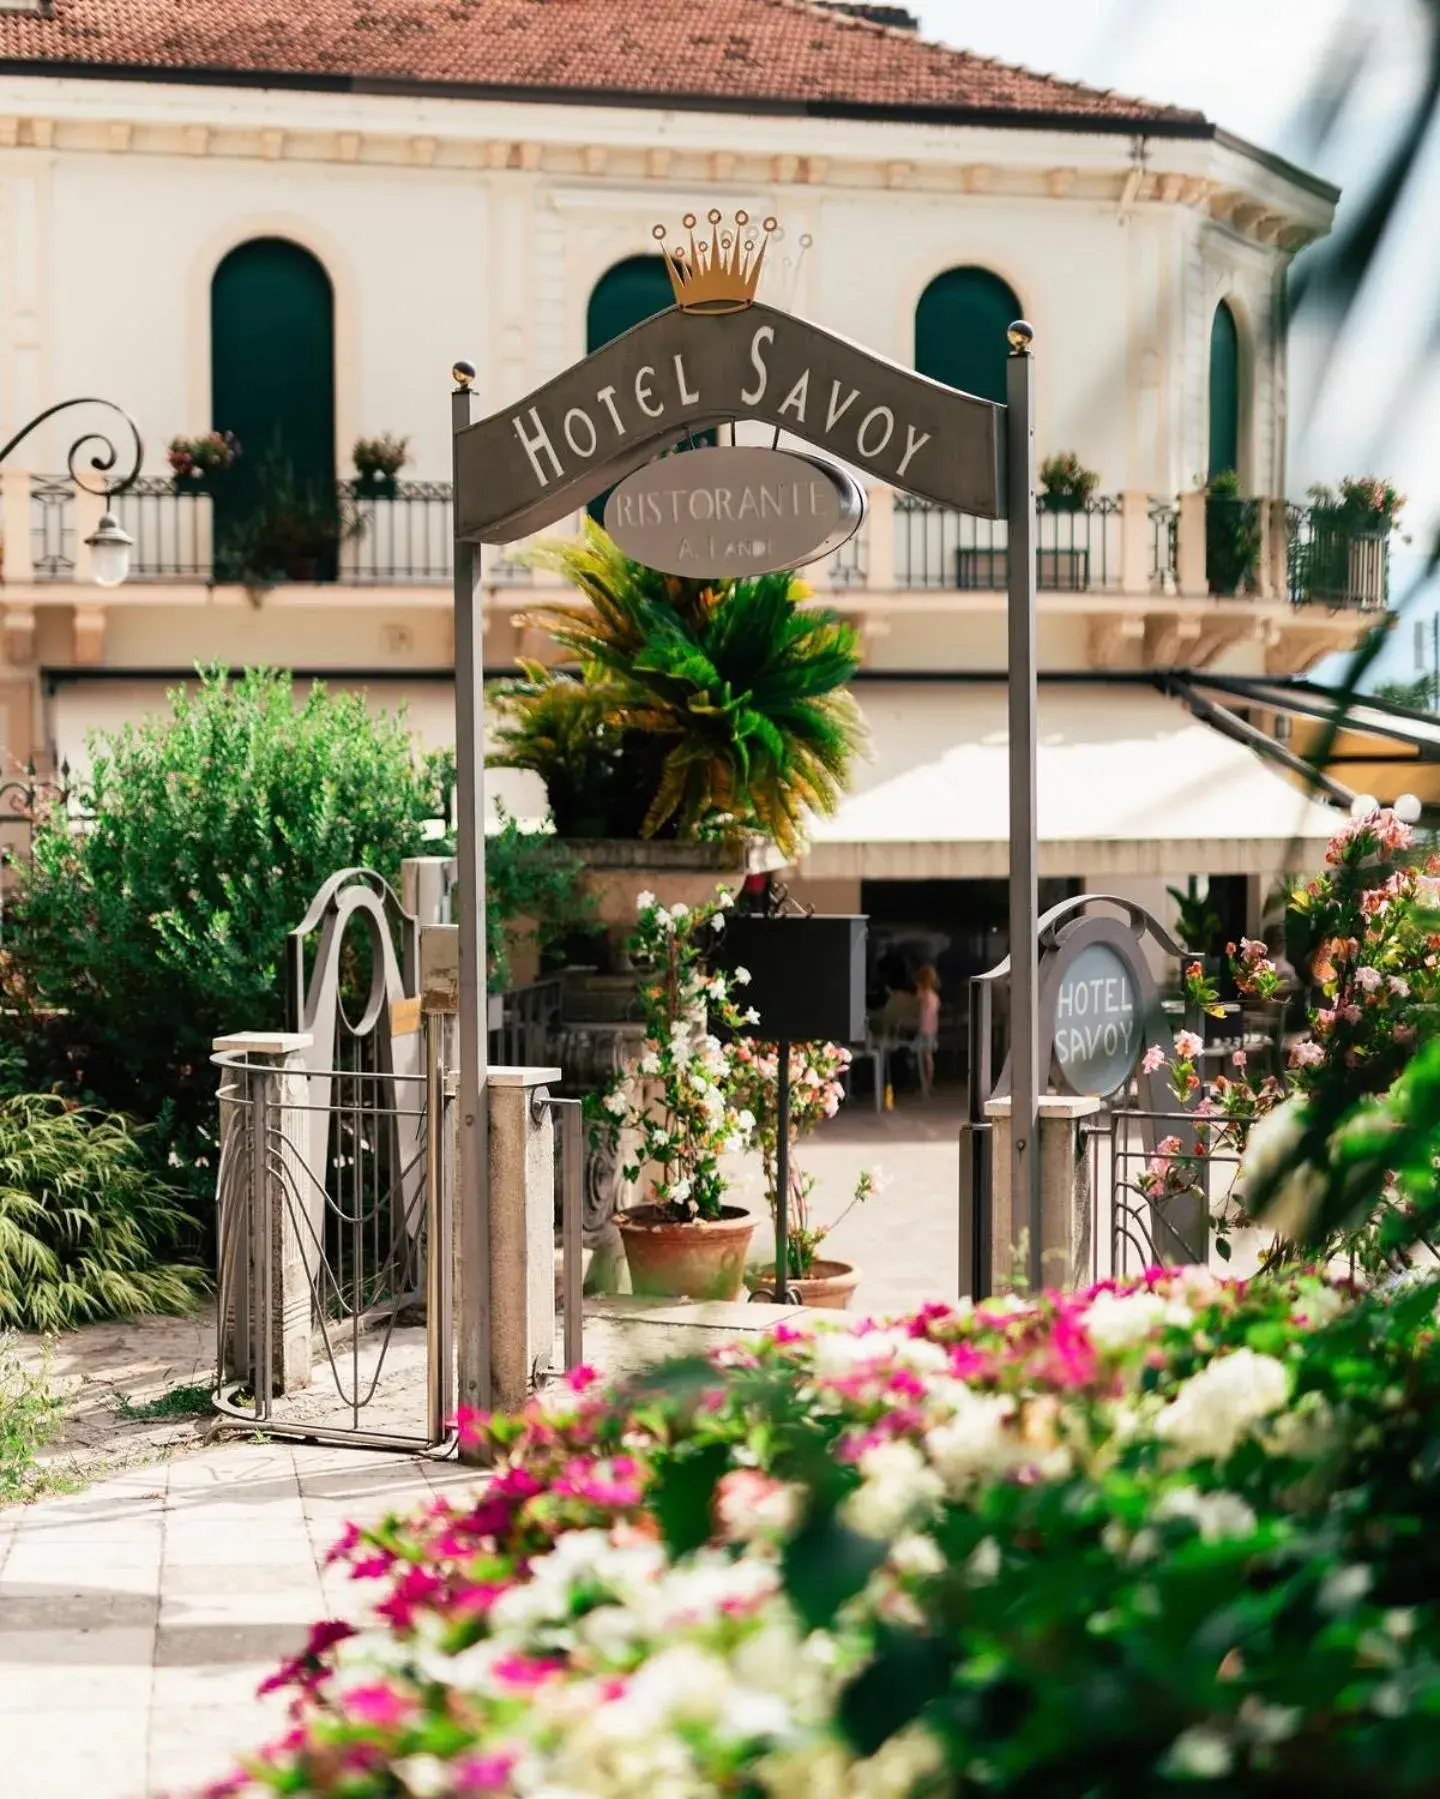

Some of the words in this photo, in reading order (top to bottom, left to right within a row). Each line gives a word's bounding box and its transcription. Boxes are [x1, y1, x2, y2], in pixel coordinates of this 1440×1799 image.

[513, 353, 700, 487] HOTEL
[741, 325, 931, 477] SAVOY
[616, 480, 828, 528] RISTORANTE
[1057, 977, 1133, 1019] HOTEL
[1055, 1021, 1133, 1064] SAVOY
